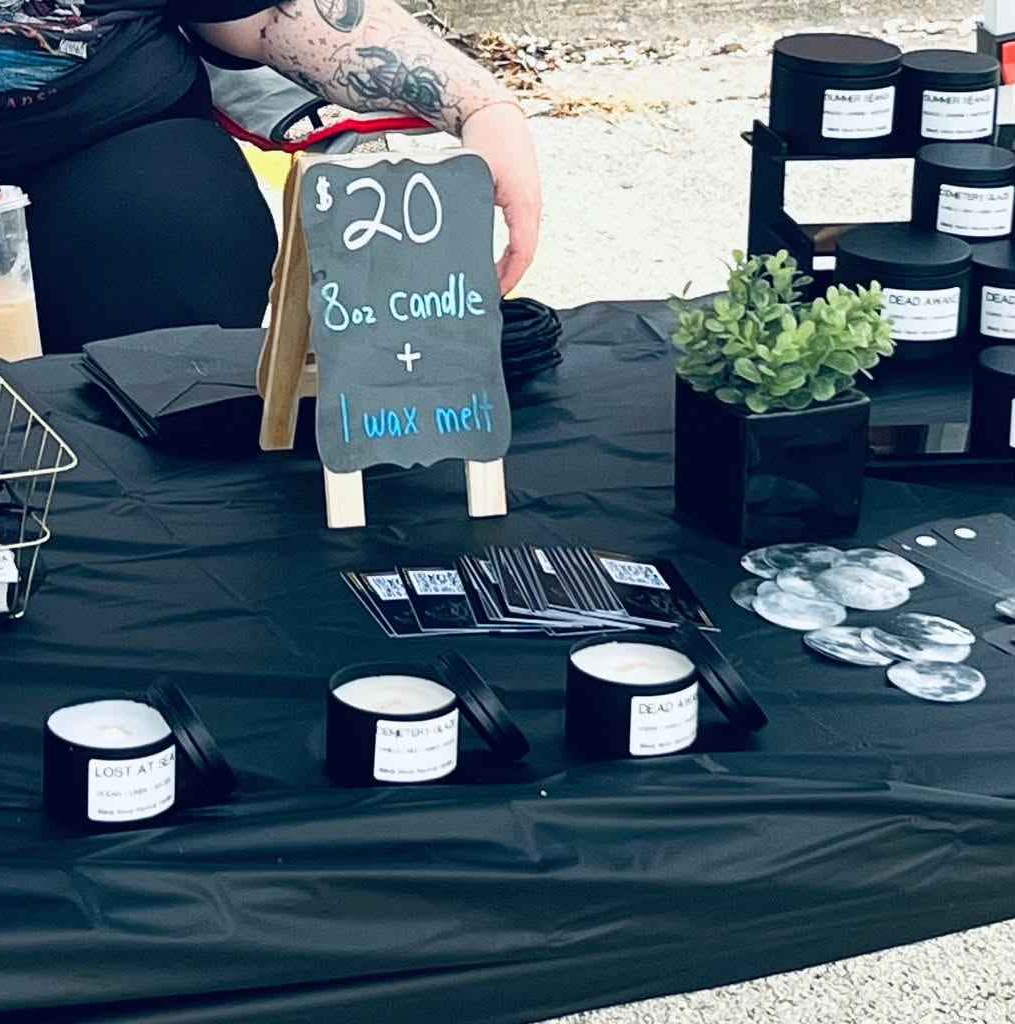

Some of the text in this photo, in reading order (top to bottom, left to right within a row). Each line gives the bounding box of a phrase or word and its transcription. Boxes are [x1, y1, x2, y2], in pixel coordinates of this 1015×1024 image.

[315, 172, 443, 251] $20
[320, 273, 486, 331] 8oz candle
[889, 295, 921, 306] DEAD
[363, 405, 419, 439] wax
[435, 392, 494, 444] melt
[638, 702, 674, 715] DEAD
[95, 766, 132, 778] LOST
[136, 760, 154, 775] AT
